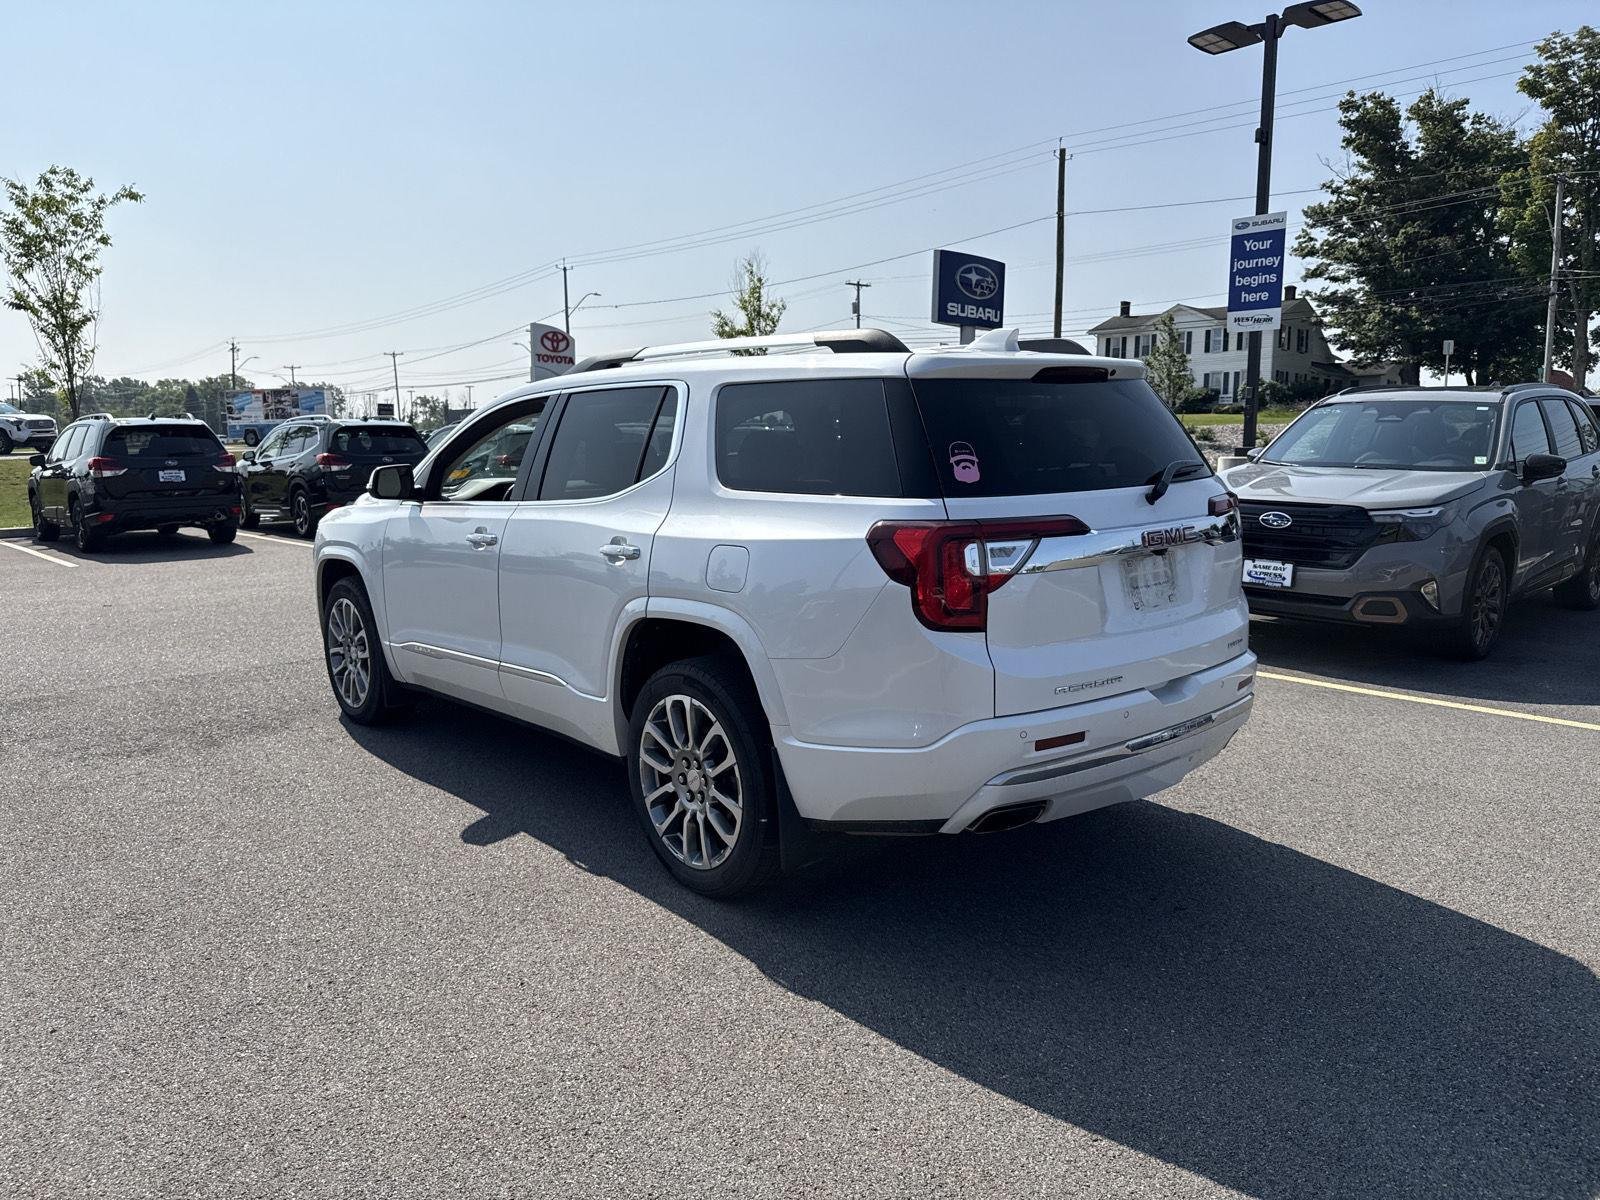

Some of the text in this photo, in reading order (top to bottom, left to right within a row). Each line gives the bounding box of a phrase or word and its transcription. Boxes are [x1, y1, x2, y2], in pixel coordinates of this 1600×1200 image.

[1251, 217, 1284, 227] SUBARU
[1244, 239, 1273, 251] Your
[1233, 256, 1281, 272] journey
[1235, 273, 1277, 287] begins
[1241, 291, 1269, 302] here
[947, 302, 999, 322] SUBARU
[536, 353, 575, 365] TOYOTA
[1141, 525, 1196, 548] GMC
